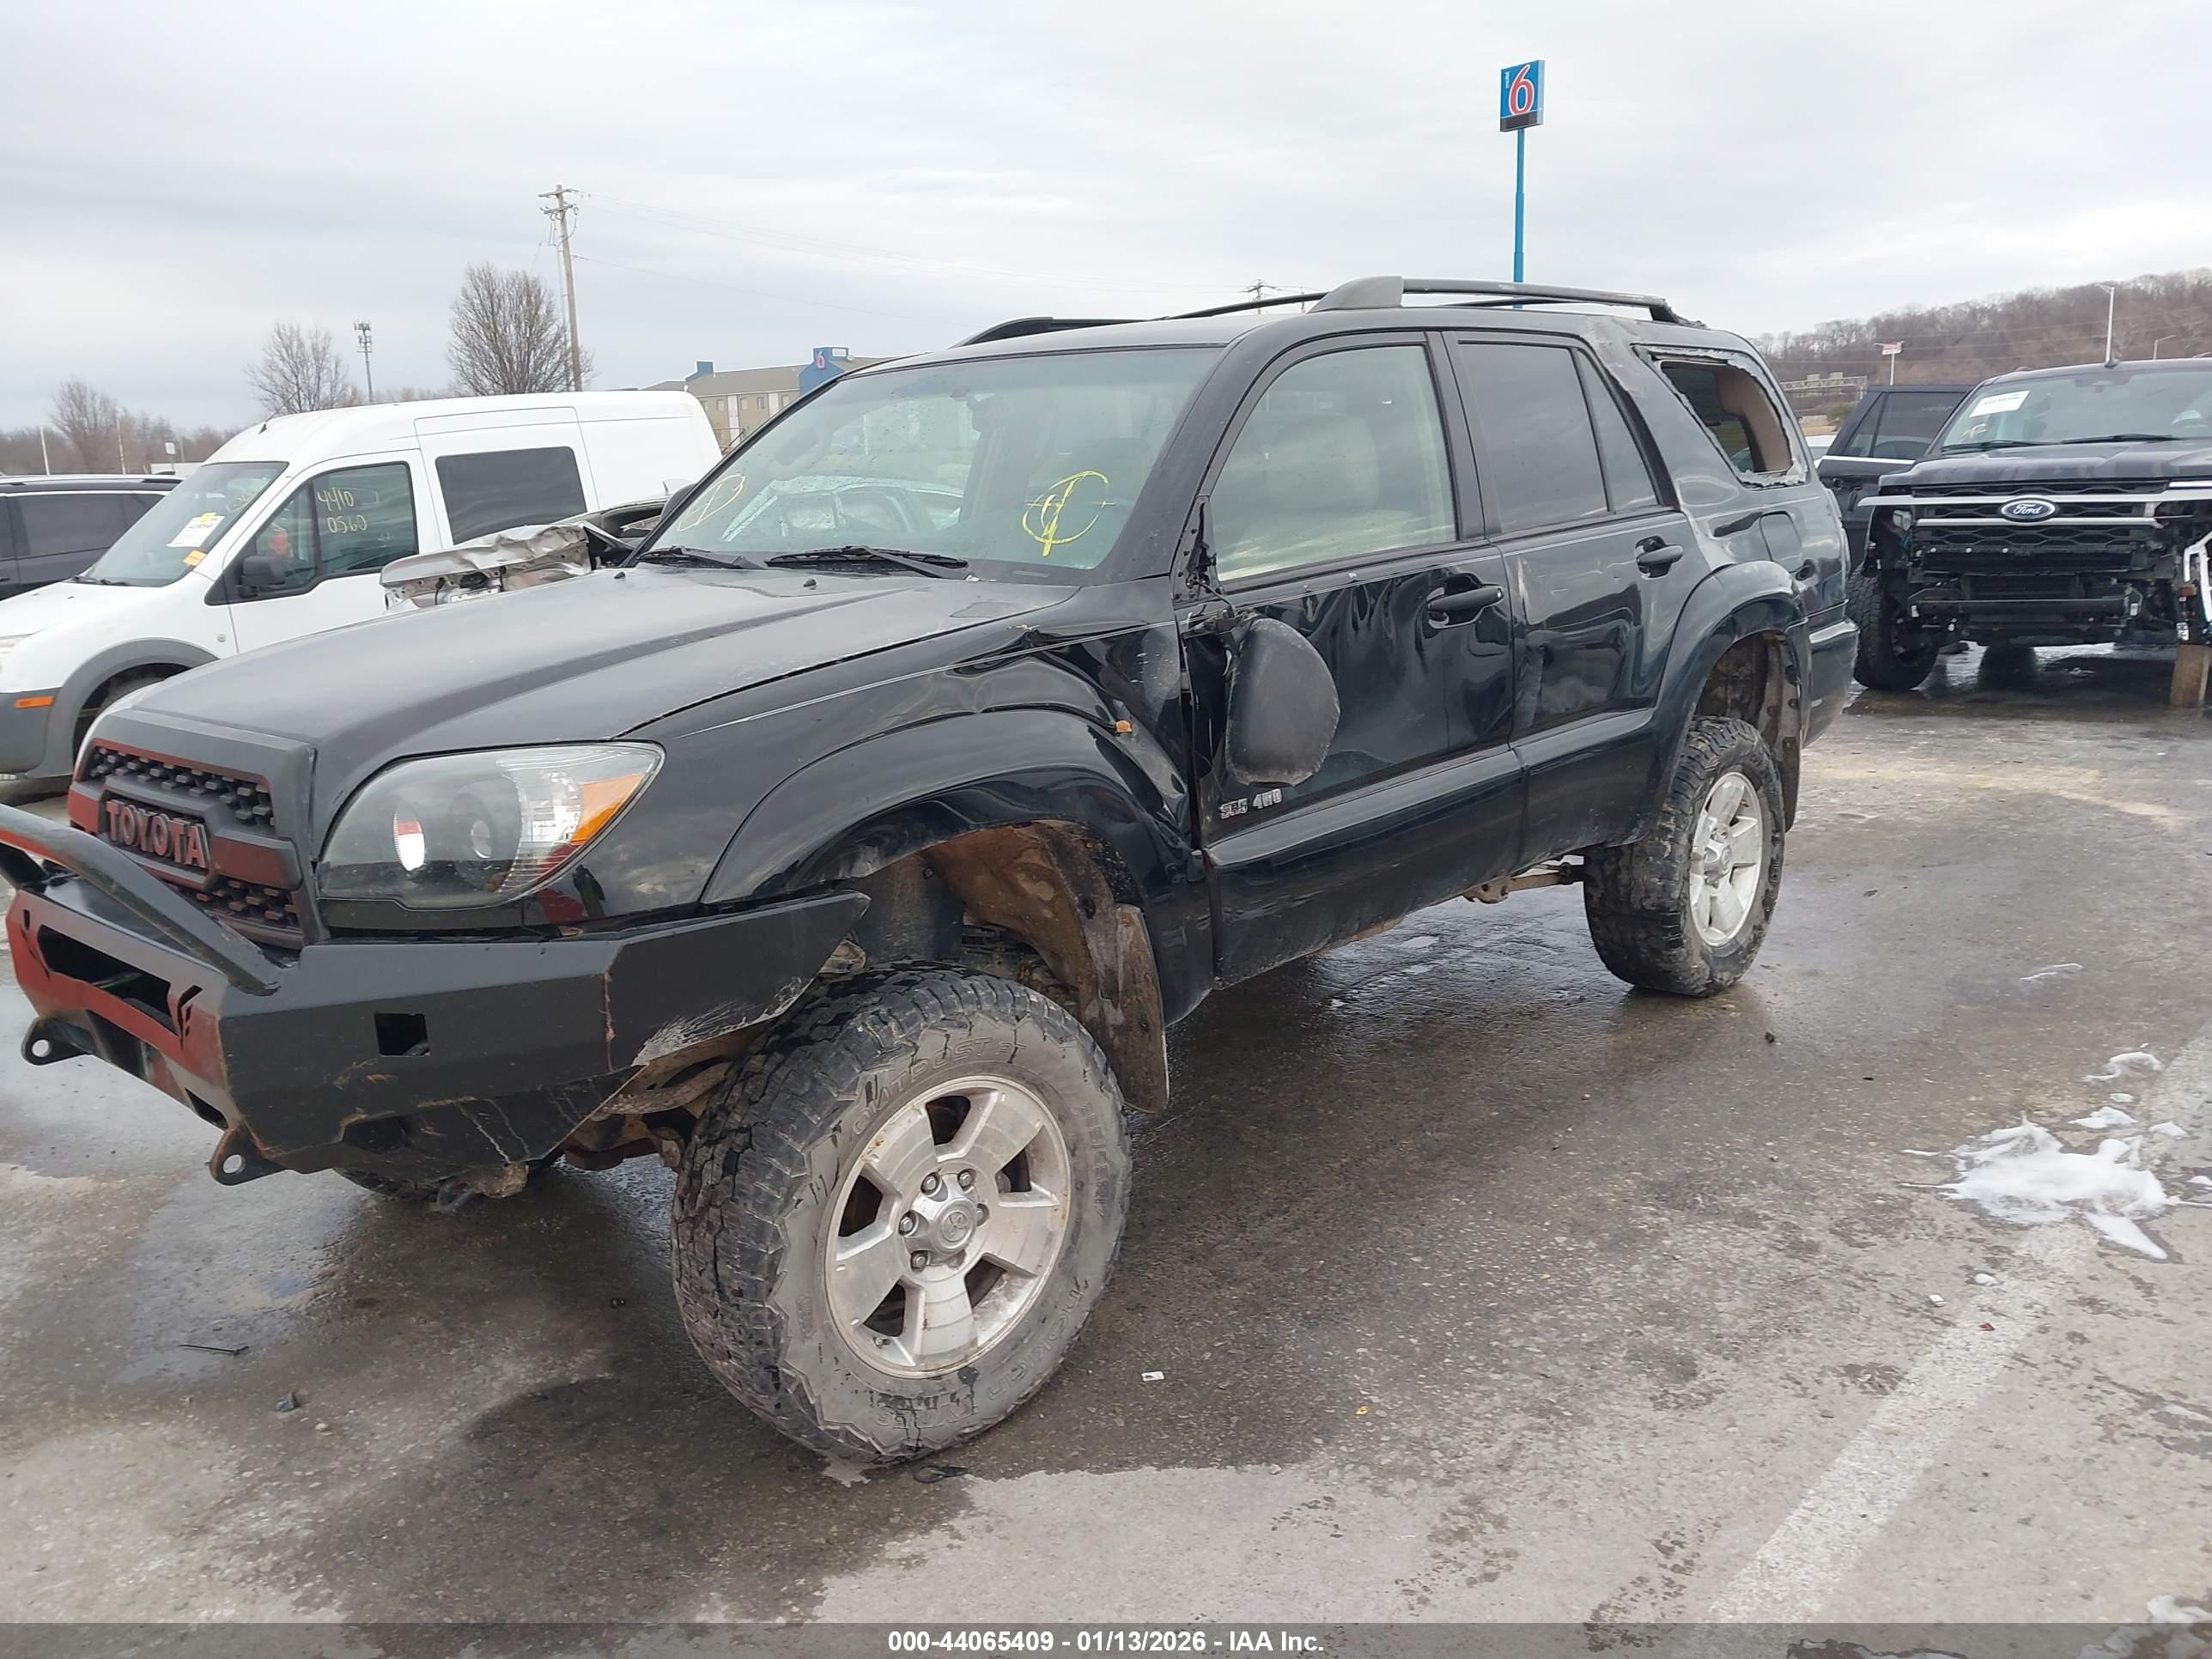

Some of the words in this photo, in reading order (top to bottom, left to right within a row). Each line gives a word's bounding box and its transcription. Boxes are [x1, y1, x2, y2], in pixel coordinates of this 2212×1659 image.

[1509, 64, 1534, 115] 6
[816, 350, 825, 369] 6
[318, 488, 354, 511] 4410
[2013, 503, 2044, 515] Ford
[327, 514, 367, 533] 0560
[1253, 788, 1282, 809] 4WD
[106, 799, 210, 868] TOYOTA
